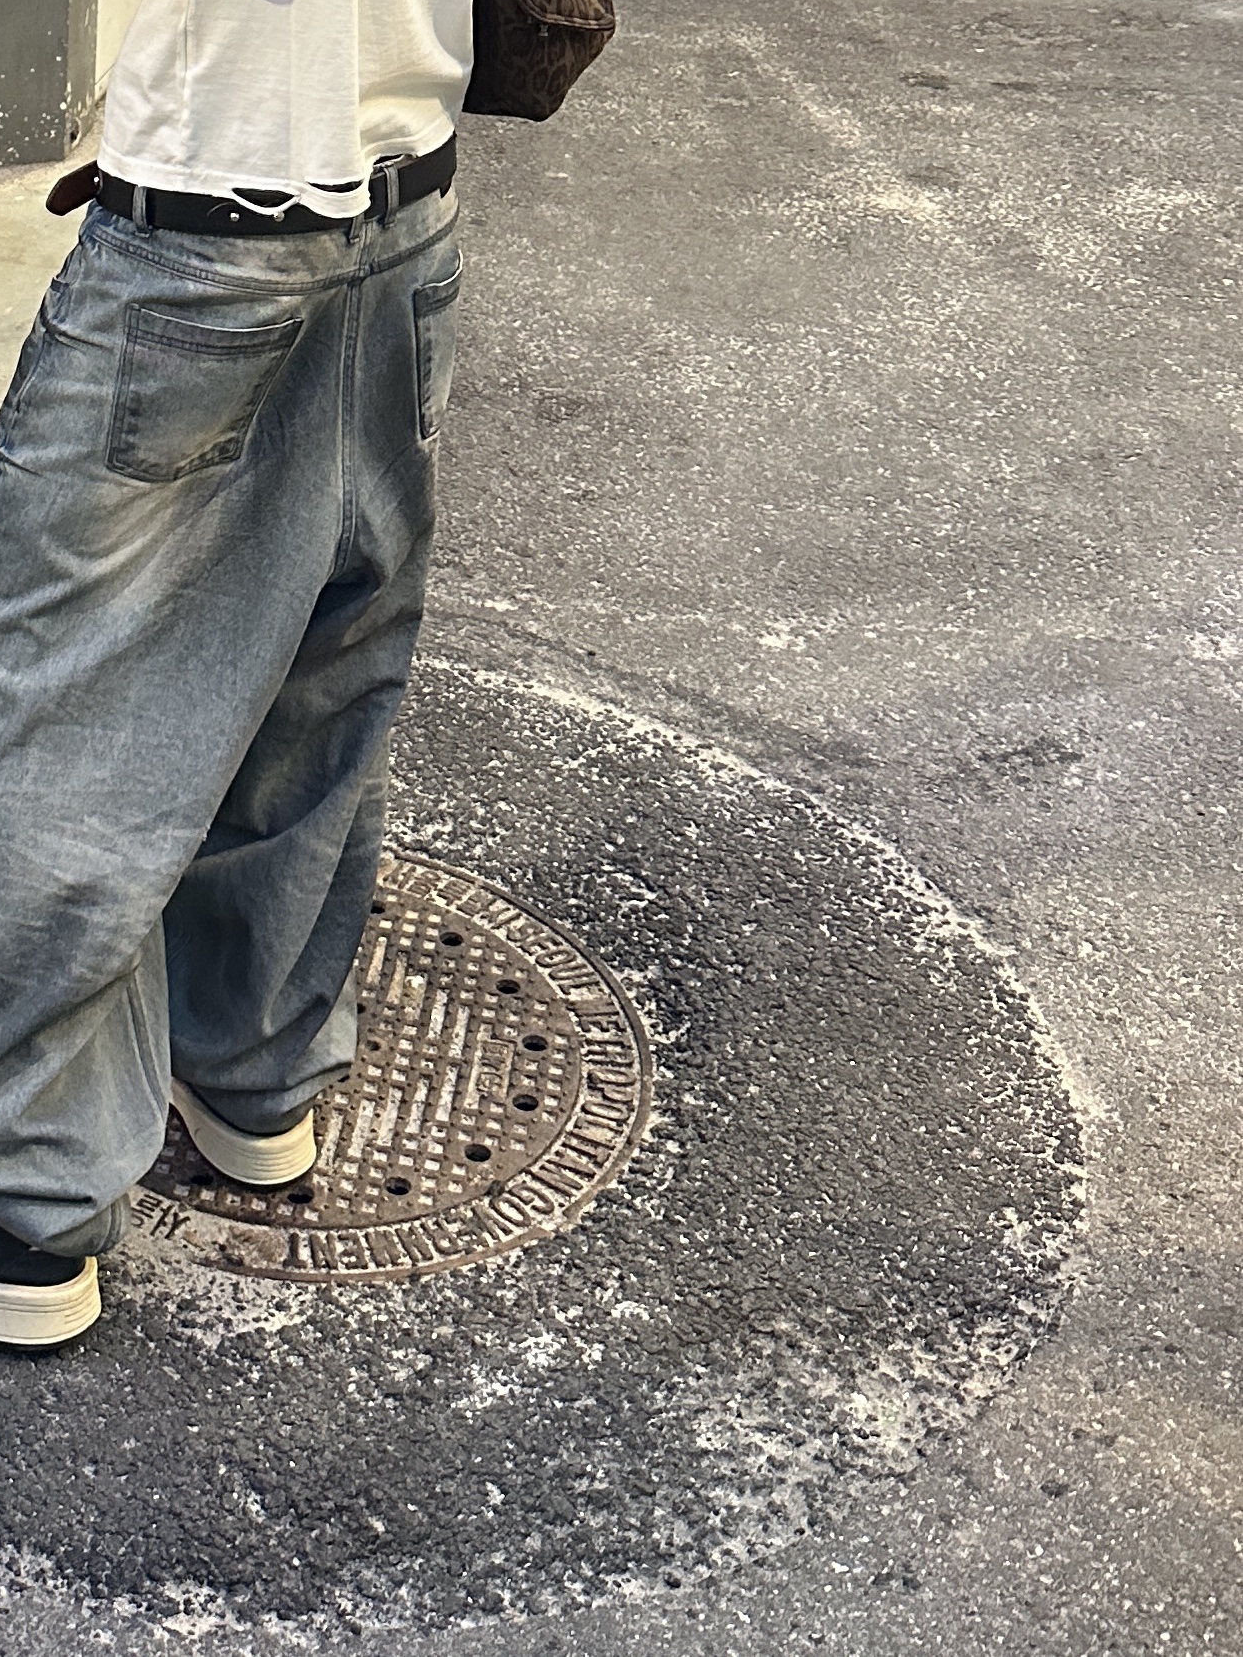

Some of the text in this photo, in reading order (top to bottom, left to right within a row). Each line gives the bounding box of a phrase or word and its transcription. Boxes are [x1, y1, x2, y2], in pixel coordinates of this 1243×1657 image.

[282, 920, 638, 1270] SEOUL METROPOLITAN GOVERNMENT
